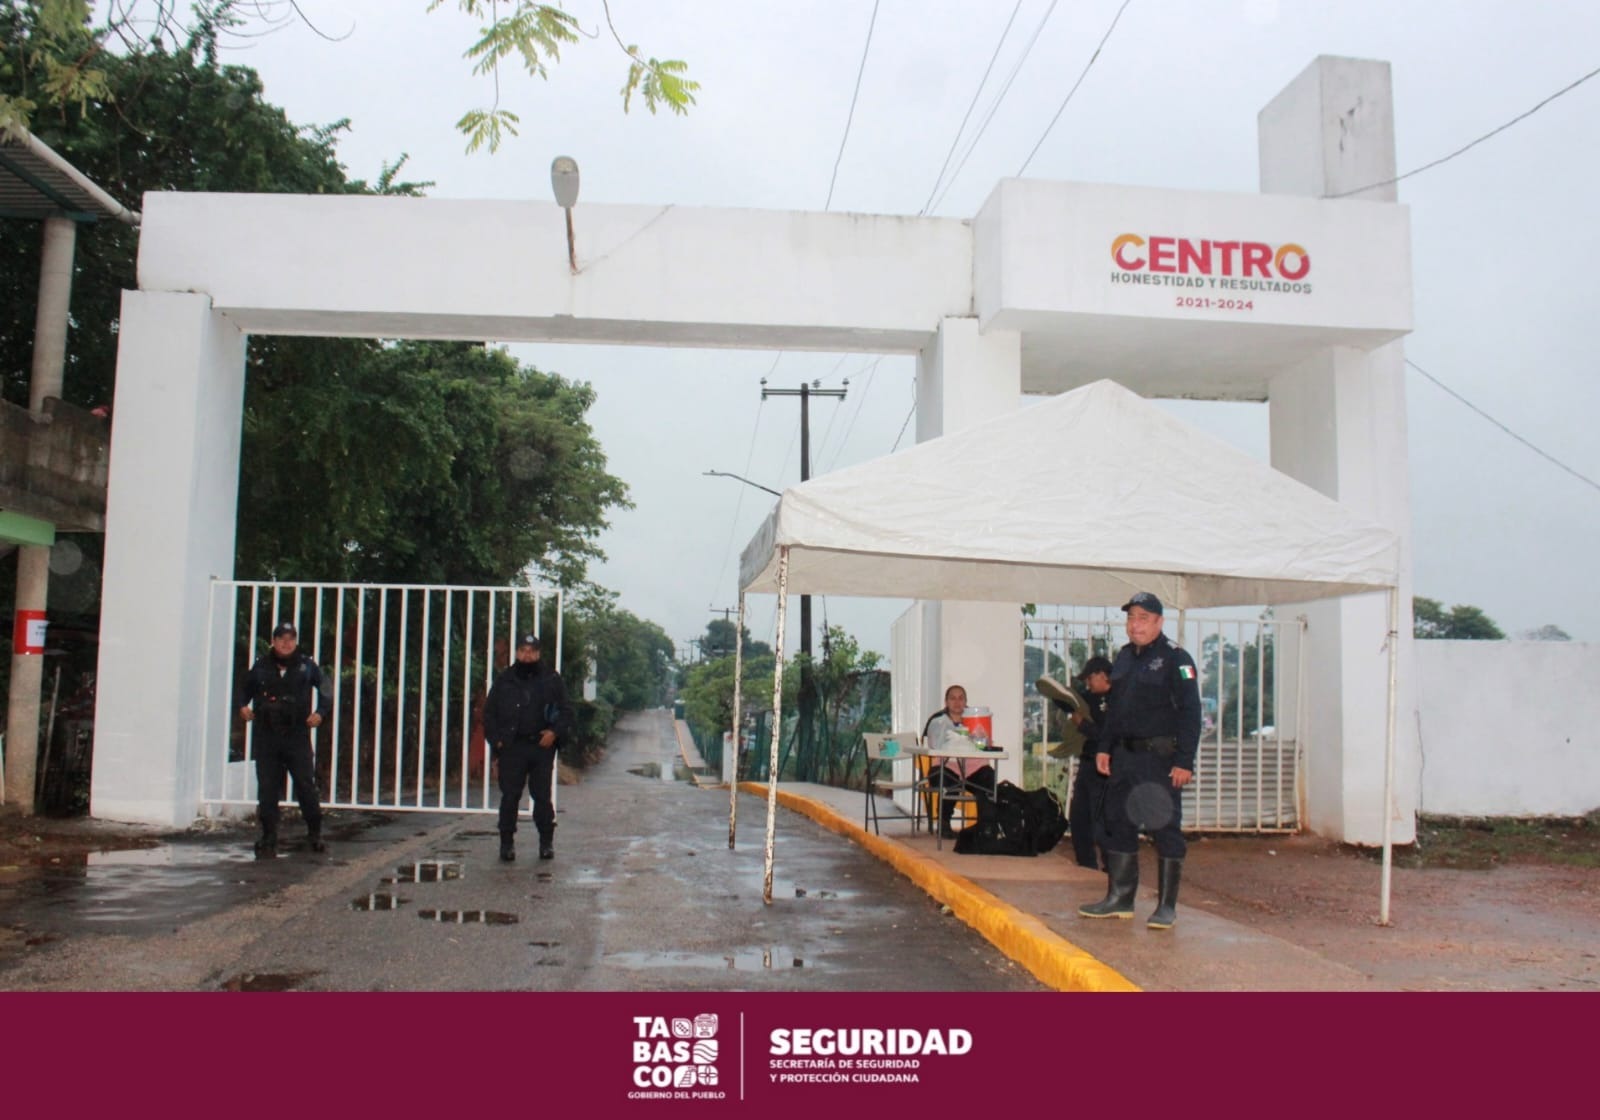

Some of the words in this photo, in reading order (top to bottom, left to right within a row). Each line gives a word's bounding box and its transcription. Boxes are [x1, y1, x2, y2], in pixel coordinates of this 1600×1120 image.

[1111, 233, 1311, 281] CENTRO
[1111, 272, 1205, 288] HONESTIDAD
[1208, 278, 1217, 289] Y
[1219, 278, 1313, 295] RESULTADOS
[1176, 297, 1254, 311] 2021-2024
